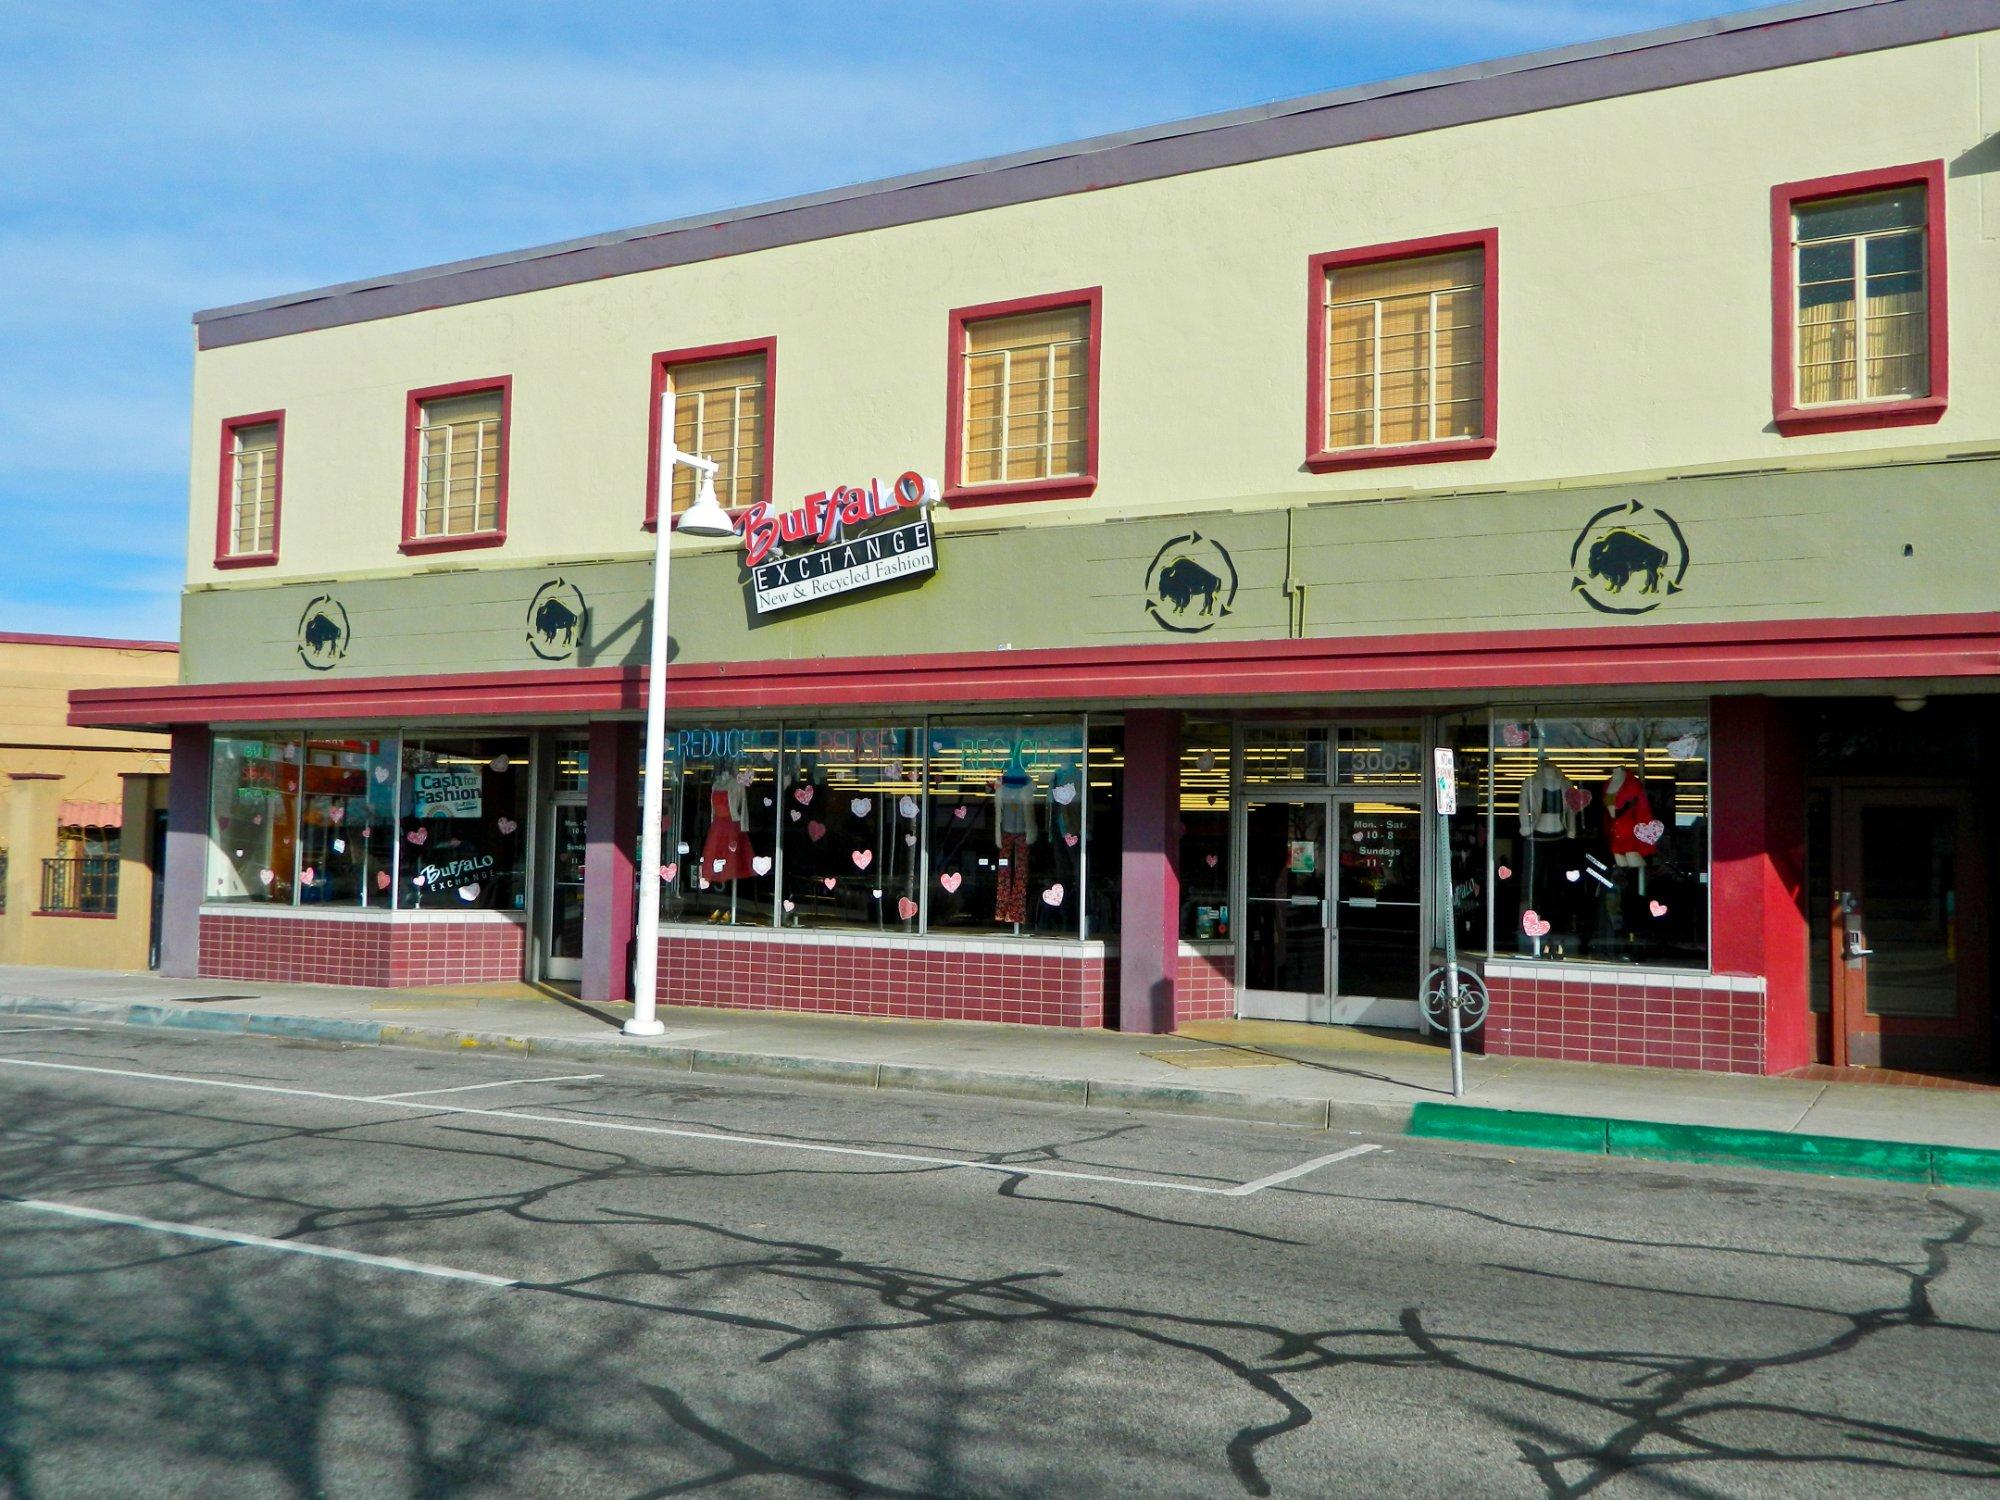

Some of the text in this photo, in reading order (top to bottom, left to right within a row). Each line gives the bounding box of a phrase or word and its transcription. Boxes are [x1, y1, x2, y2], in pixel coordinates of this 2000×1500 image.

[757, 525, 928, 590] EXCHANGE
[759, 554, 931, 609] New & Recycled Fashion
[677, 728, 751, 759] REDUCE
[818, 730, 889, 761] REUSE
[1352, 753, 1411, 771] 3005
[421, 773, 478, 789] Cash for
[415, 786, 484, 804] Fashion
[1354, 820, 1377, 829] Mon.
[1386, 820, 1407, 829] Sat.
[1366, 831, 1378, 839] 10
[1387, 831, 1394, 840] 8
[1360, 846, 1400, 857] Sundays
[1366, 859, 1376, 867] 11
[1388, 860, 1394, 868] 7
[431, 872, 495, 892] EXCHANGE
